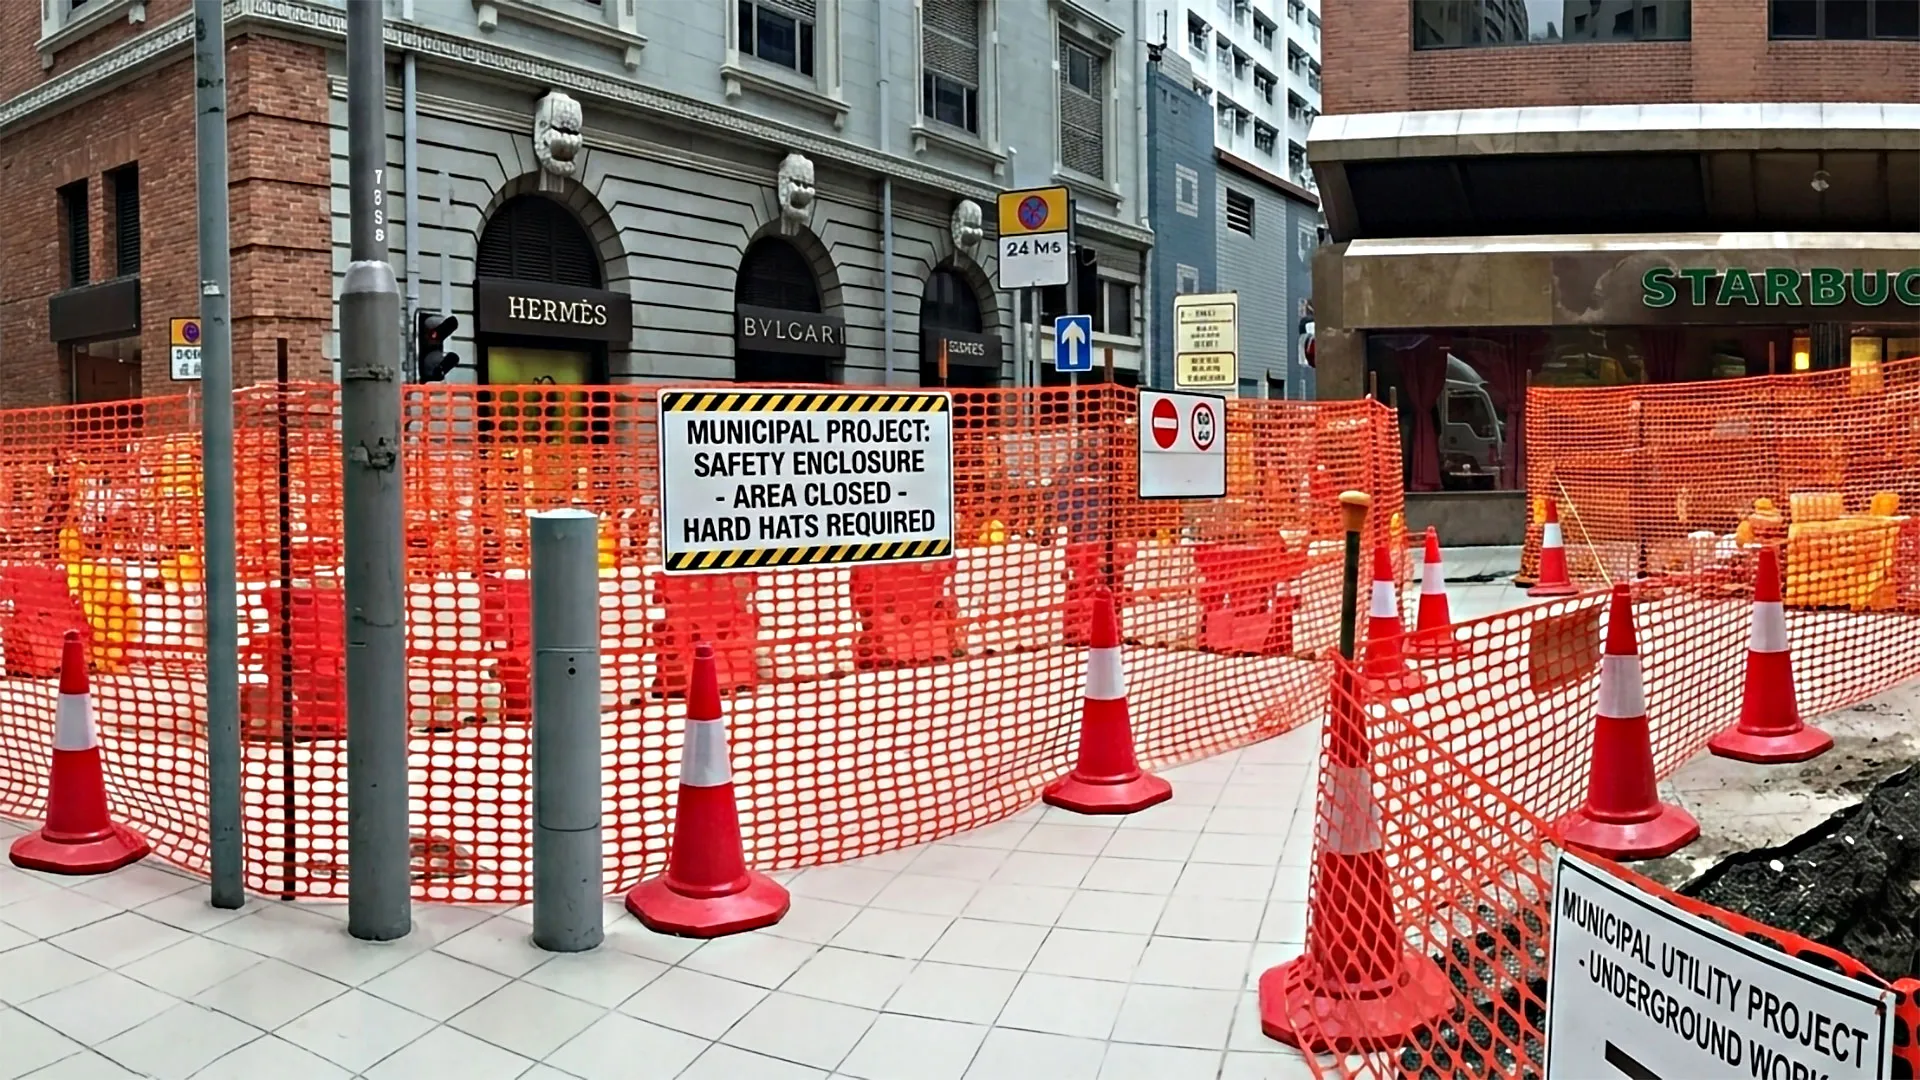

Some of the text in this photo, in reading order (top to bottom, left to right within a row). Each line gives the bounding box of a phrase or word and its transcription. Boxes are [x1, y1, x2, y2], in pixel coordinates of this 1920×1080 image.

[1007, 240, 1029, 257] 24
[1642, 268, 1920, 307] STARBUC
[687, 419, 931, 445] MUNICIPAL PROJECT:
[694, 449, 925, 478] SAFETY ENCLOSURE
[733, 483, 797, 509] AREA
[804, 480, 891, 507] CLOSED
[683, 509, 935, 543] HARD HATS REQUIRED
[1563, 887, 1869, 1069] MUNICIPAL UTILITY PROJECT
[1590, 949, 1742, 1067] UNDERGROUND
